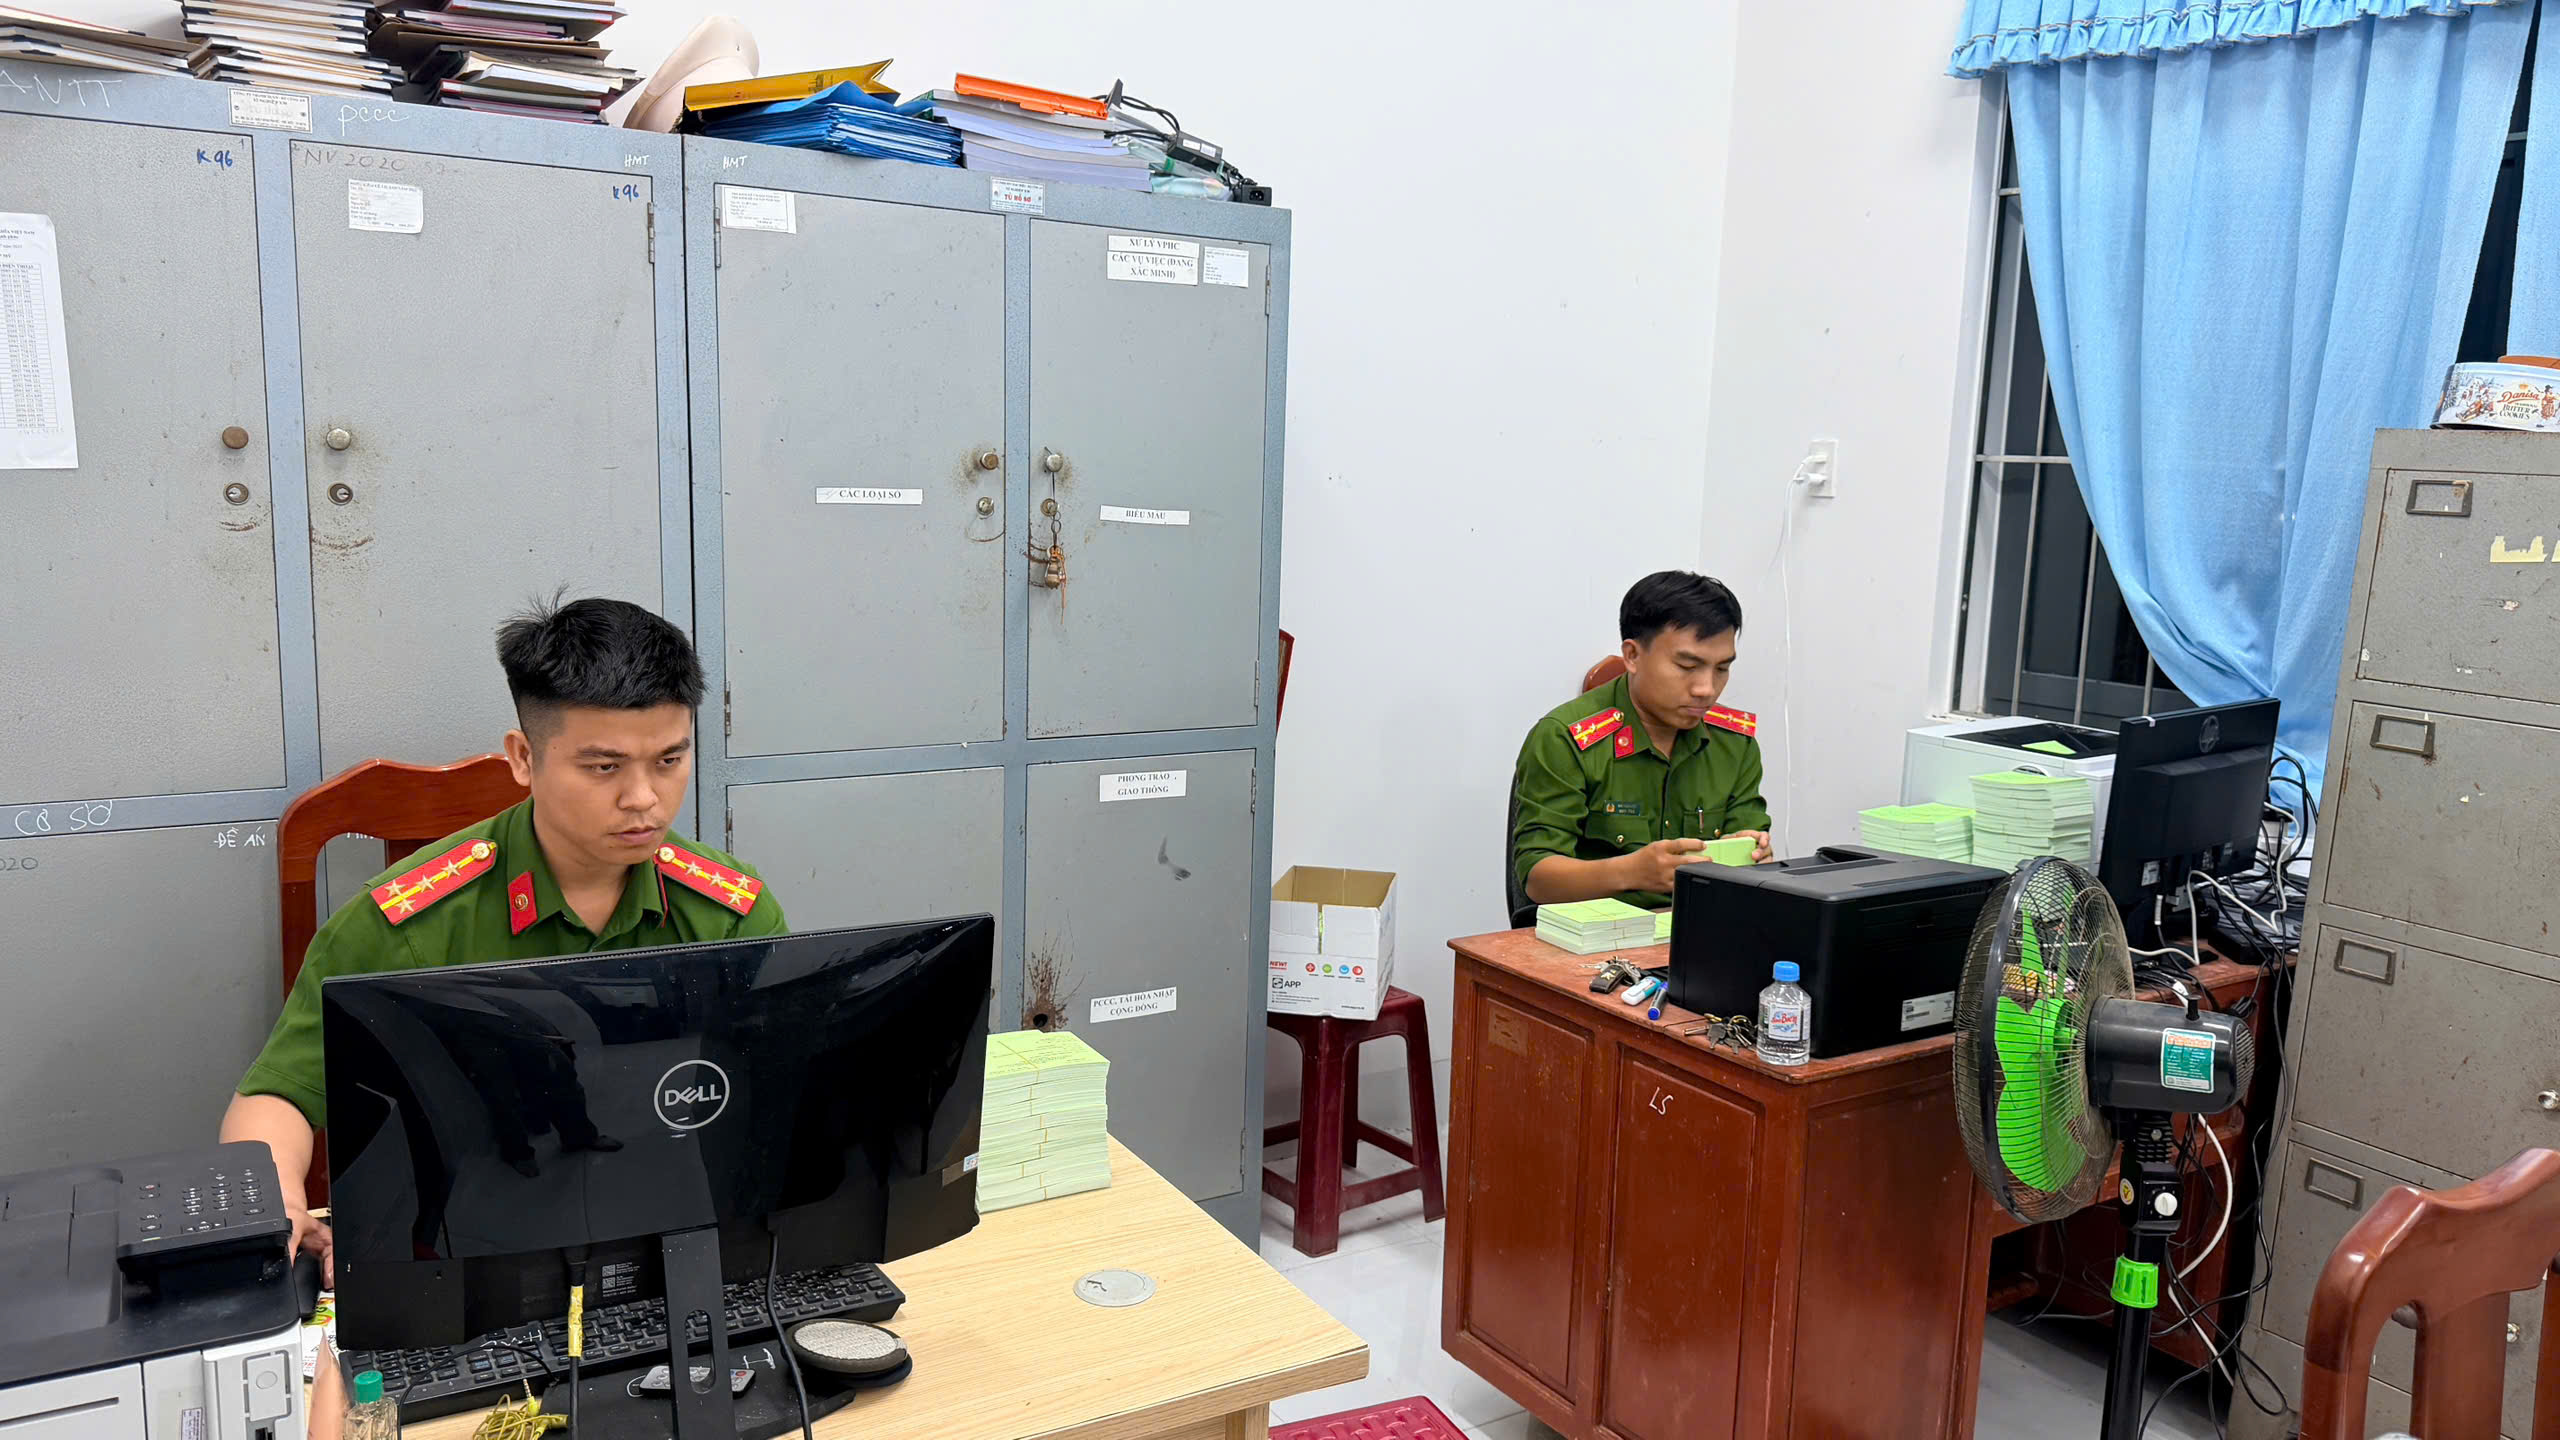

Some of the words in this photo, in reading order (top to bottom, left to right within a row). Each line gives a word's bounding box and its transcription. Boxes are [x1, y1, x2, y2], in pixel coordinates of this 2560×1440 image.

[214, 149, 233, 171] 96
[624, 154, 650, 168] HMT
[722, 155, 747, 169] HMT
[622, 184, 639, 202] 96
[1157, 240, 1180, 251] VPHC
[1132, 254, 1144, 266] VỤ
[1145, 256, 1166, 267] VIỆC
[1130, 266, 1149, 277] XÁC
[1150, 268, 1176, 280] MINH)
[2496, 391, 2540, 402] Danisa
[862, 489, 886, 500] LOẠI
[1117, 787, 1139, 796] GIAO
[1140, 784, 1169, 794] THÔNG
[1284, 980, 1301, 988] APP
[664, 1084, 722, 1106] DELL
